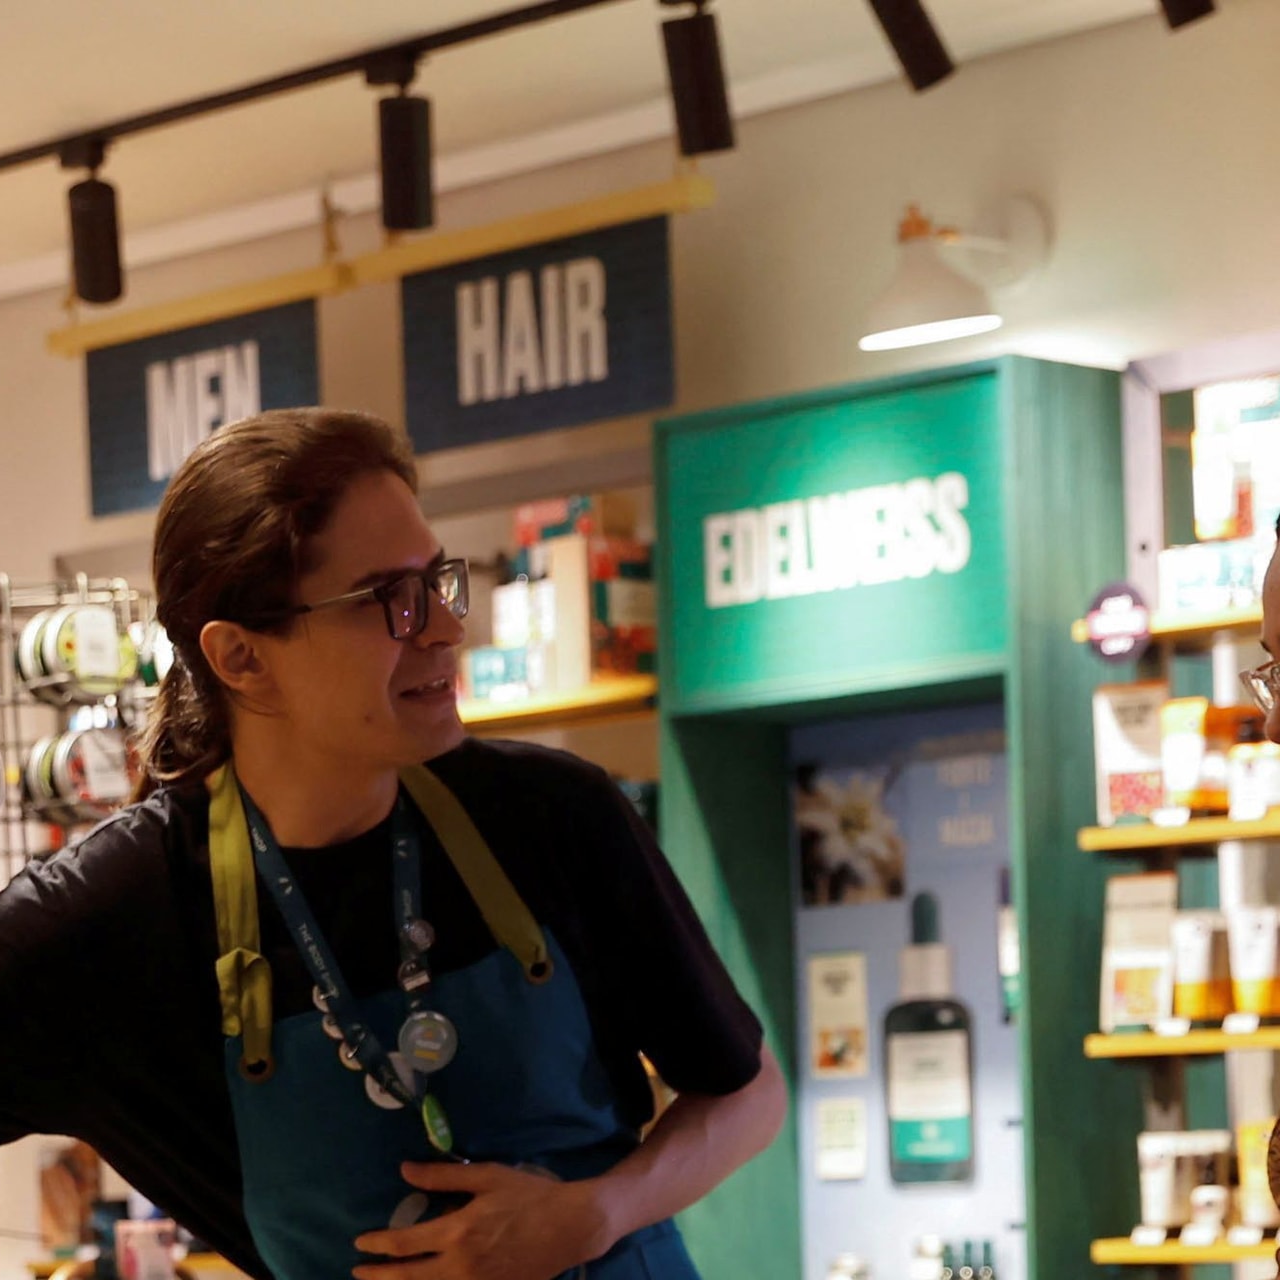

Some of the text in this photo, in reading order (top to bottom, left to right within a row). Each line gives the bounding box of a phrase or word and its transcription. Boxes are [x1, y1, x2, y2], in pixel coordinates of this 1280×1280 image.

[456, 257, 608, 406] HAIR
[146, 341, 261, 482] MEN
[704, 471, 971, 608] EDELWEISS
